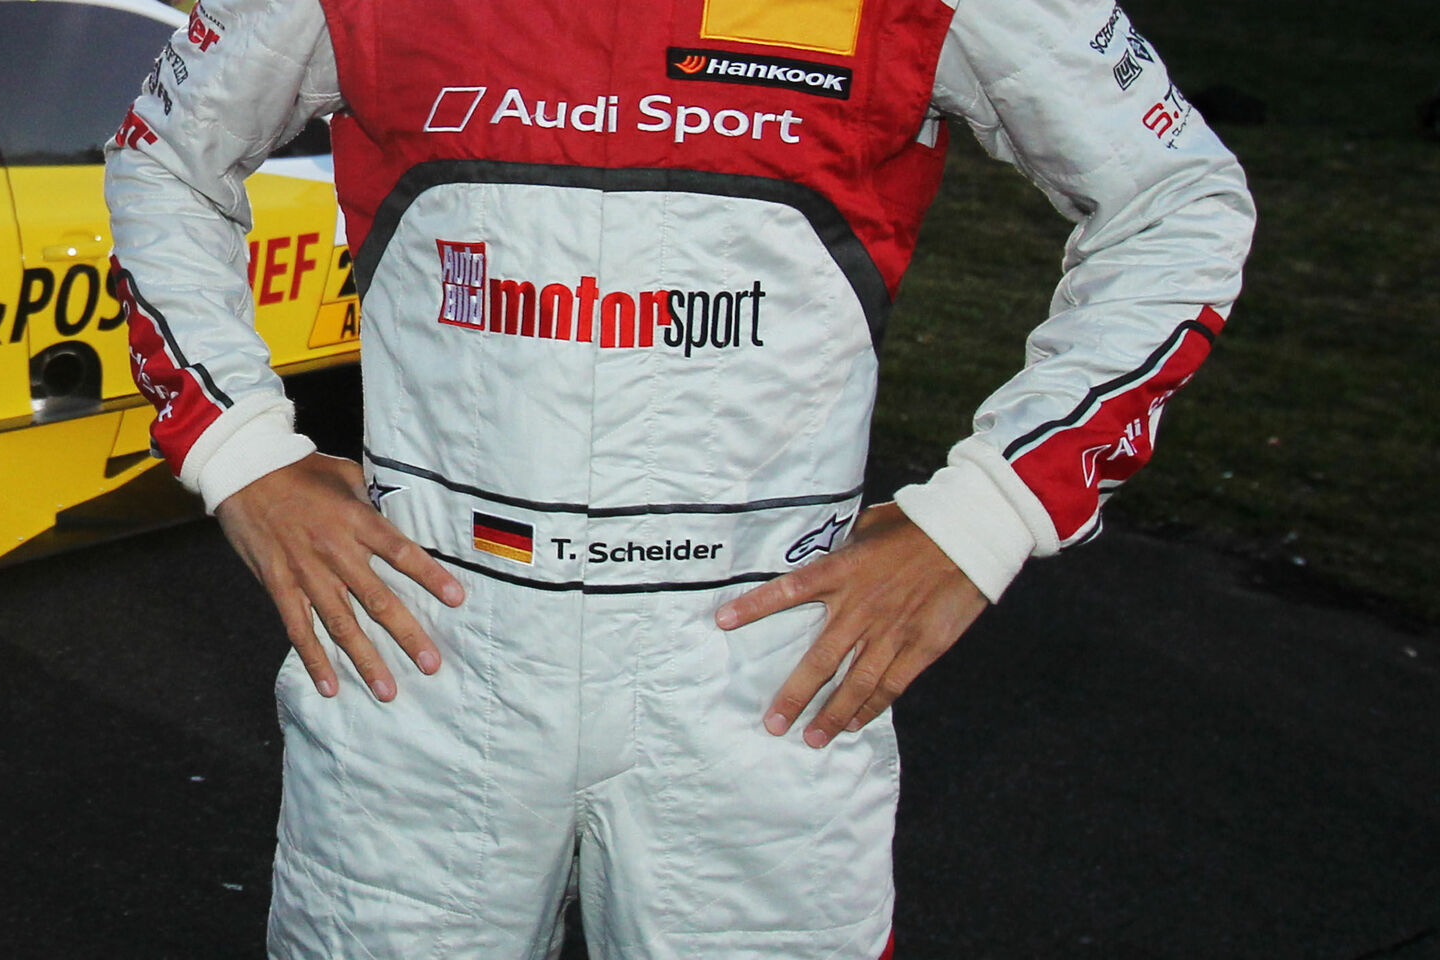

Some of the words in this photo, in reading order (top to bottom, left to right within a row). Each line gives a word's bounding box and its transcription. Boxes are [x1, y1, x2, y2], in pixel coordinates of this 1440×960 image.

[489, 88, 618, 133] Audi
[637, 94, 803, 144] Sport
[551, 538, 576, 562] T.
[587, 538, 723, 564] Scheider
